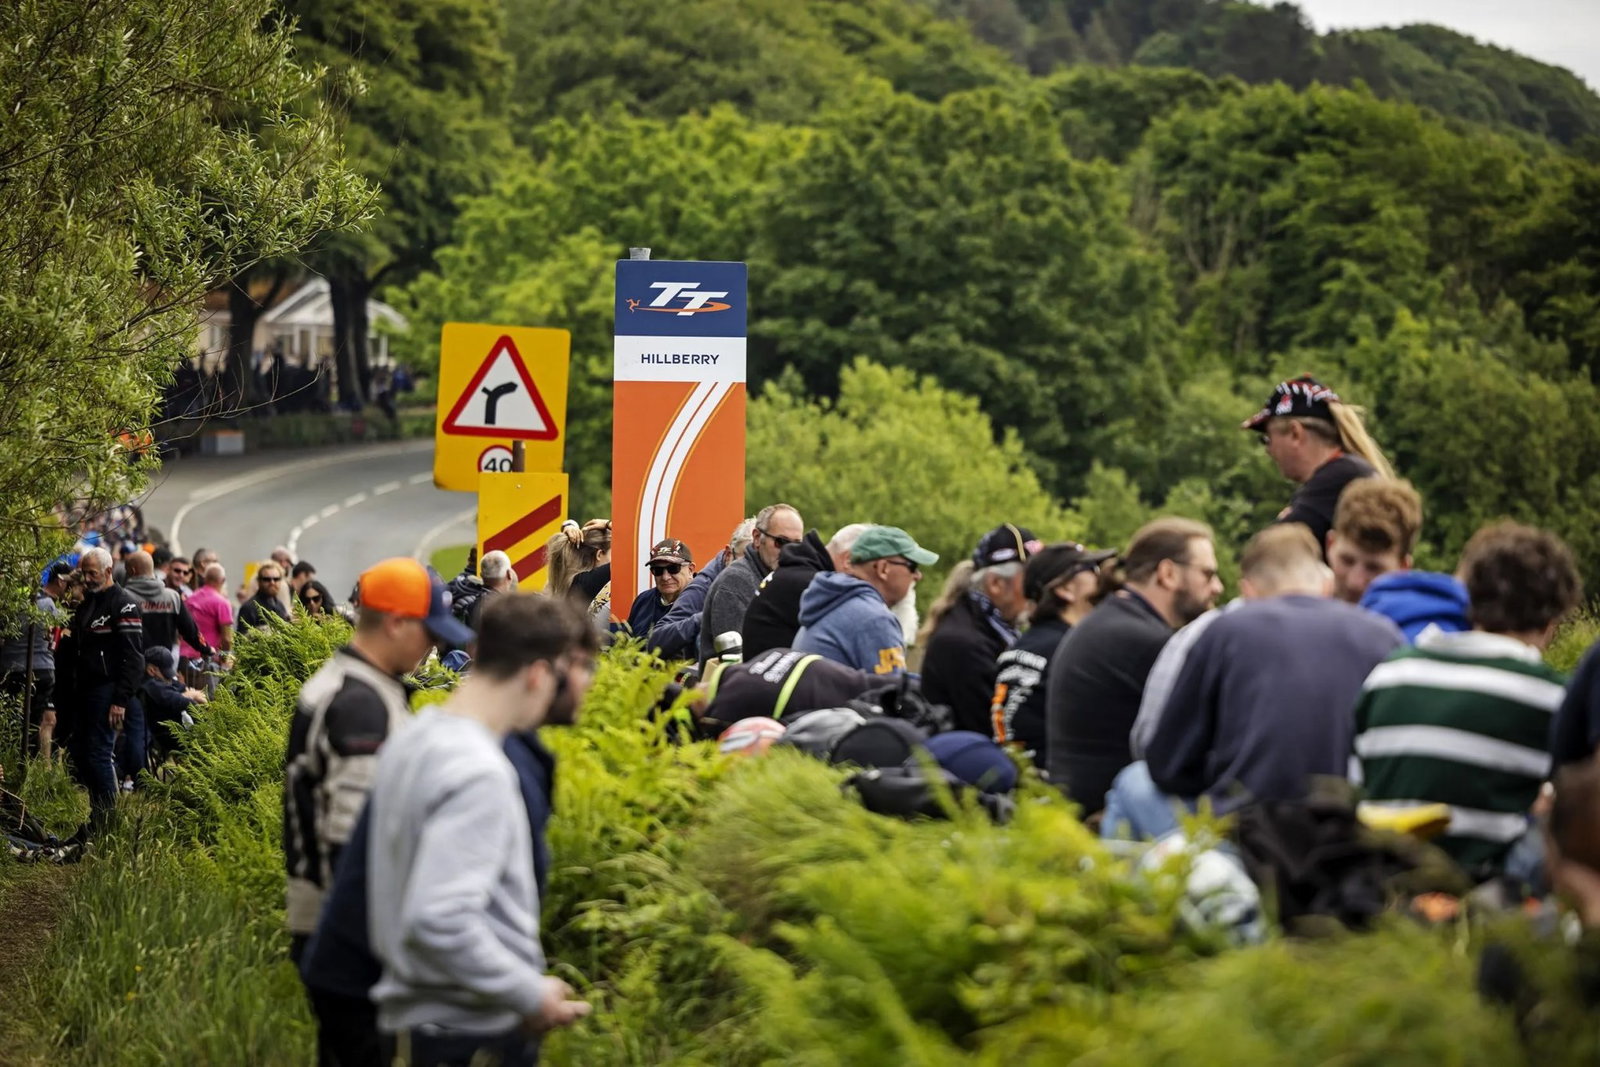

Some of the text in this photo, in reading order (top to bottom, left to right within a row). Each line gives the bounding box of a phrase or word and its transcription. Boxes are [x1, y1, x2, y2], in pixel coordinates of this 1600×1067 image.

[649, 281, 729, 316] TT
[641, 353, 720, 365] HILLBERRY
[484, 457, 513, 472] 40
